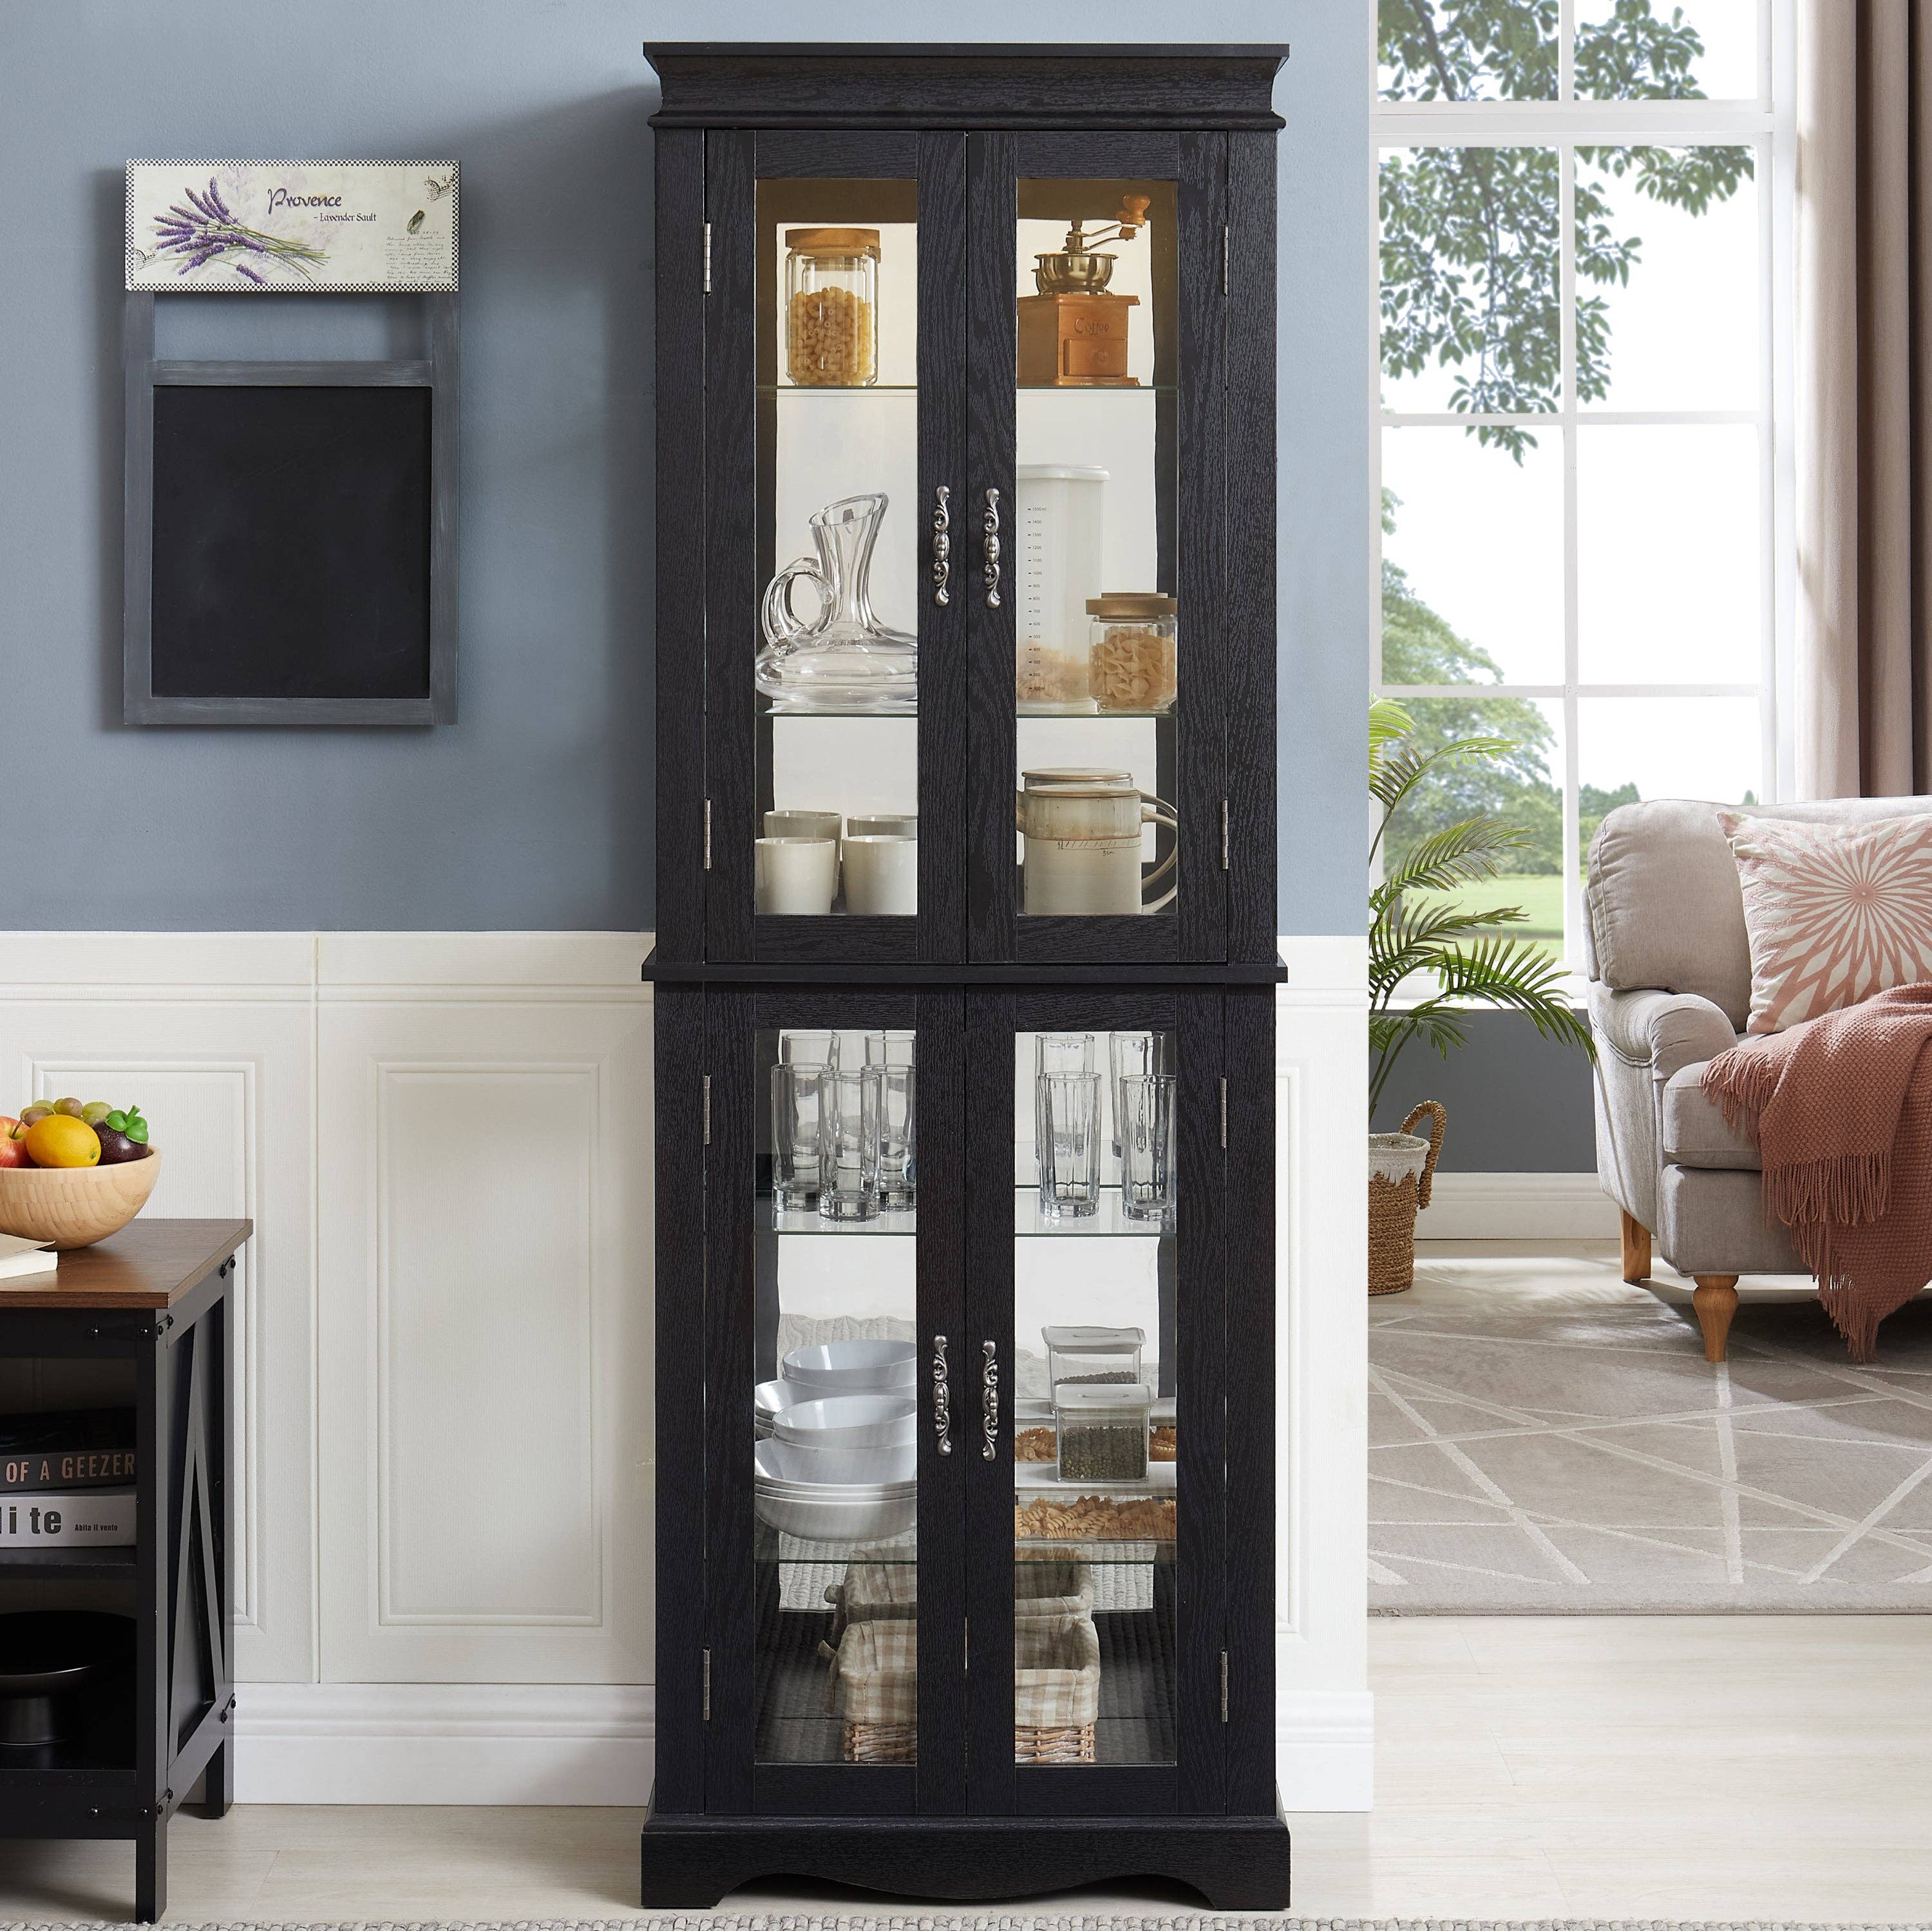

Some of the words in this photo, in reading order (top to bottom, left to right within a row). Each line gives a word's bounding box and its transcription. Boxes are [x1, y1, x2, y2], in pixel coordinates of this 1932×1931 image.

[268, 188, 342, 214] Provence
[320, 213, 355, 221] Lavender
[356, 213, 377, 221] Sault
[6, 1462, 30, 1483] OF
[39, 1460, 50, 1480] A
[61, 1453, 135, 1479] GEEZER
